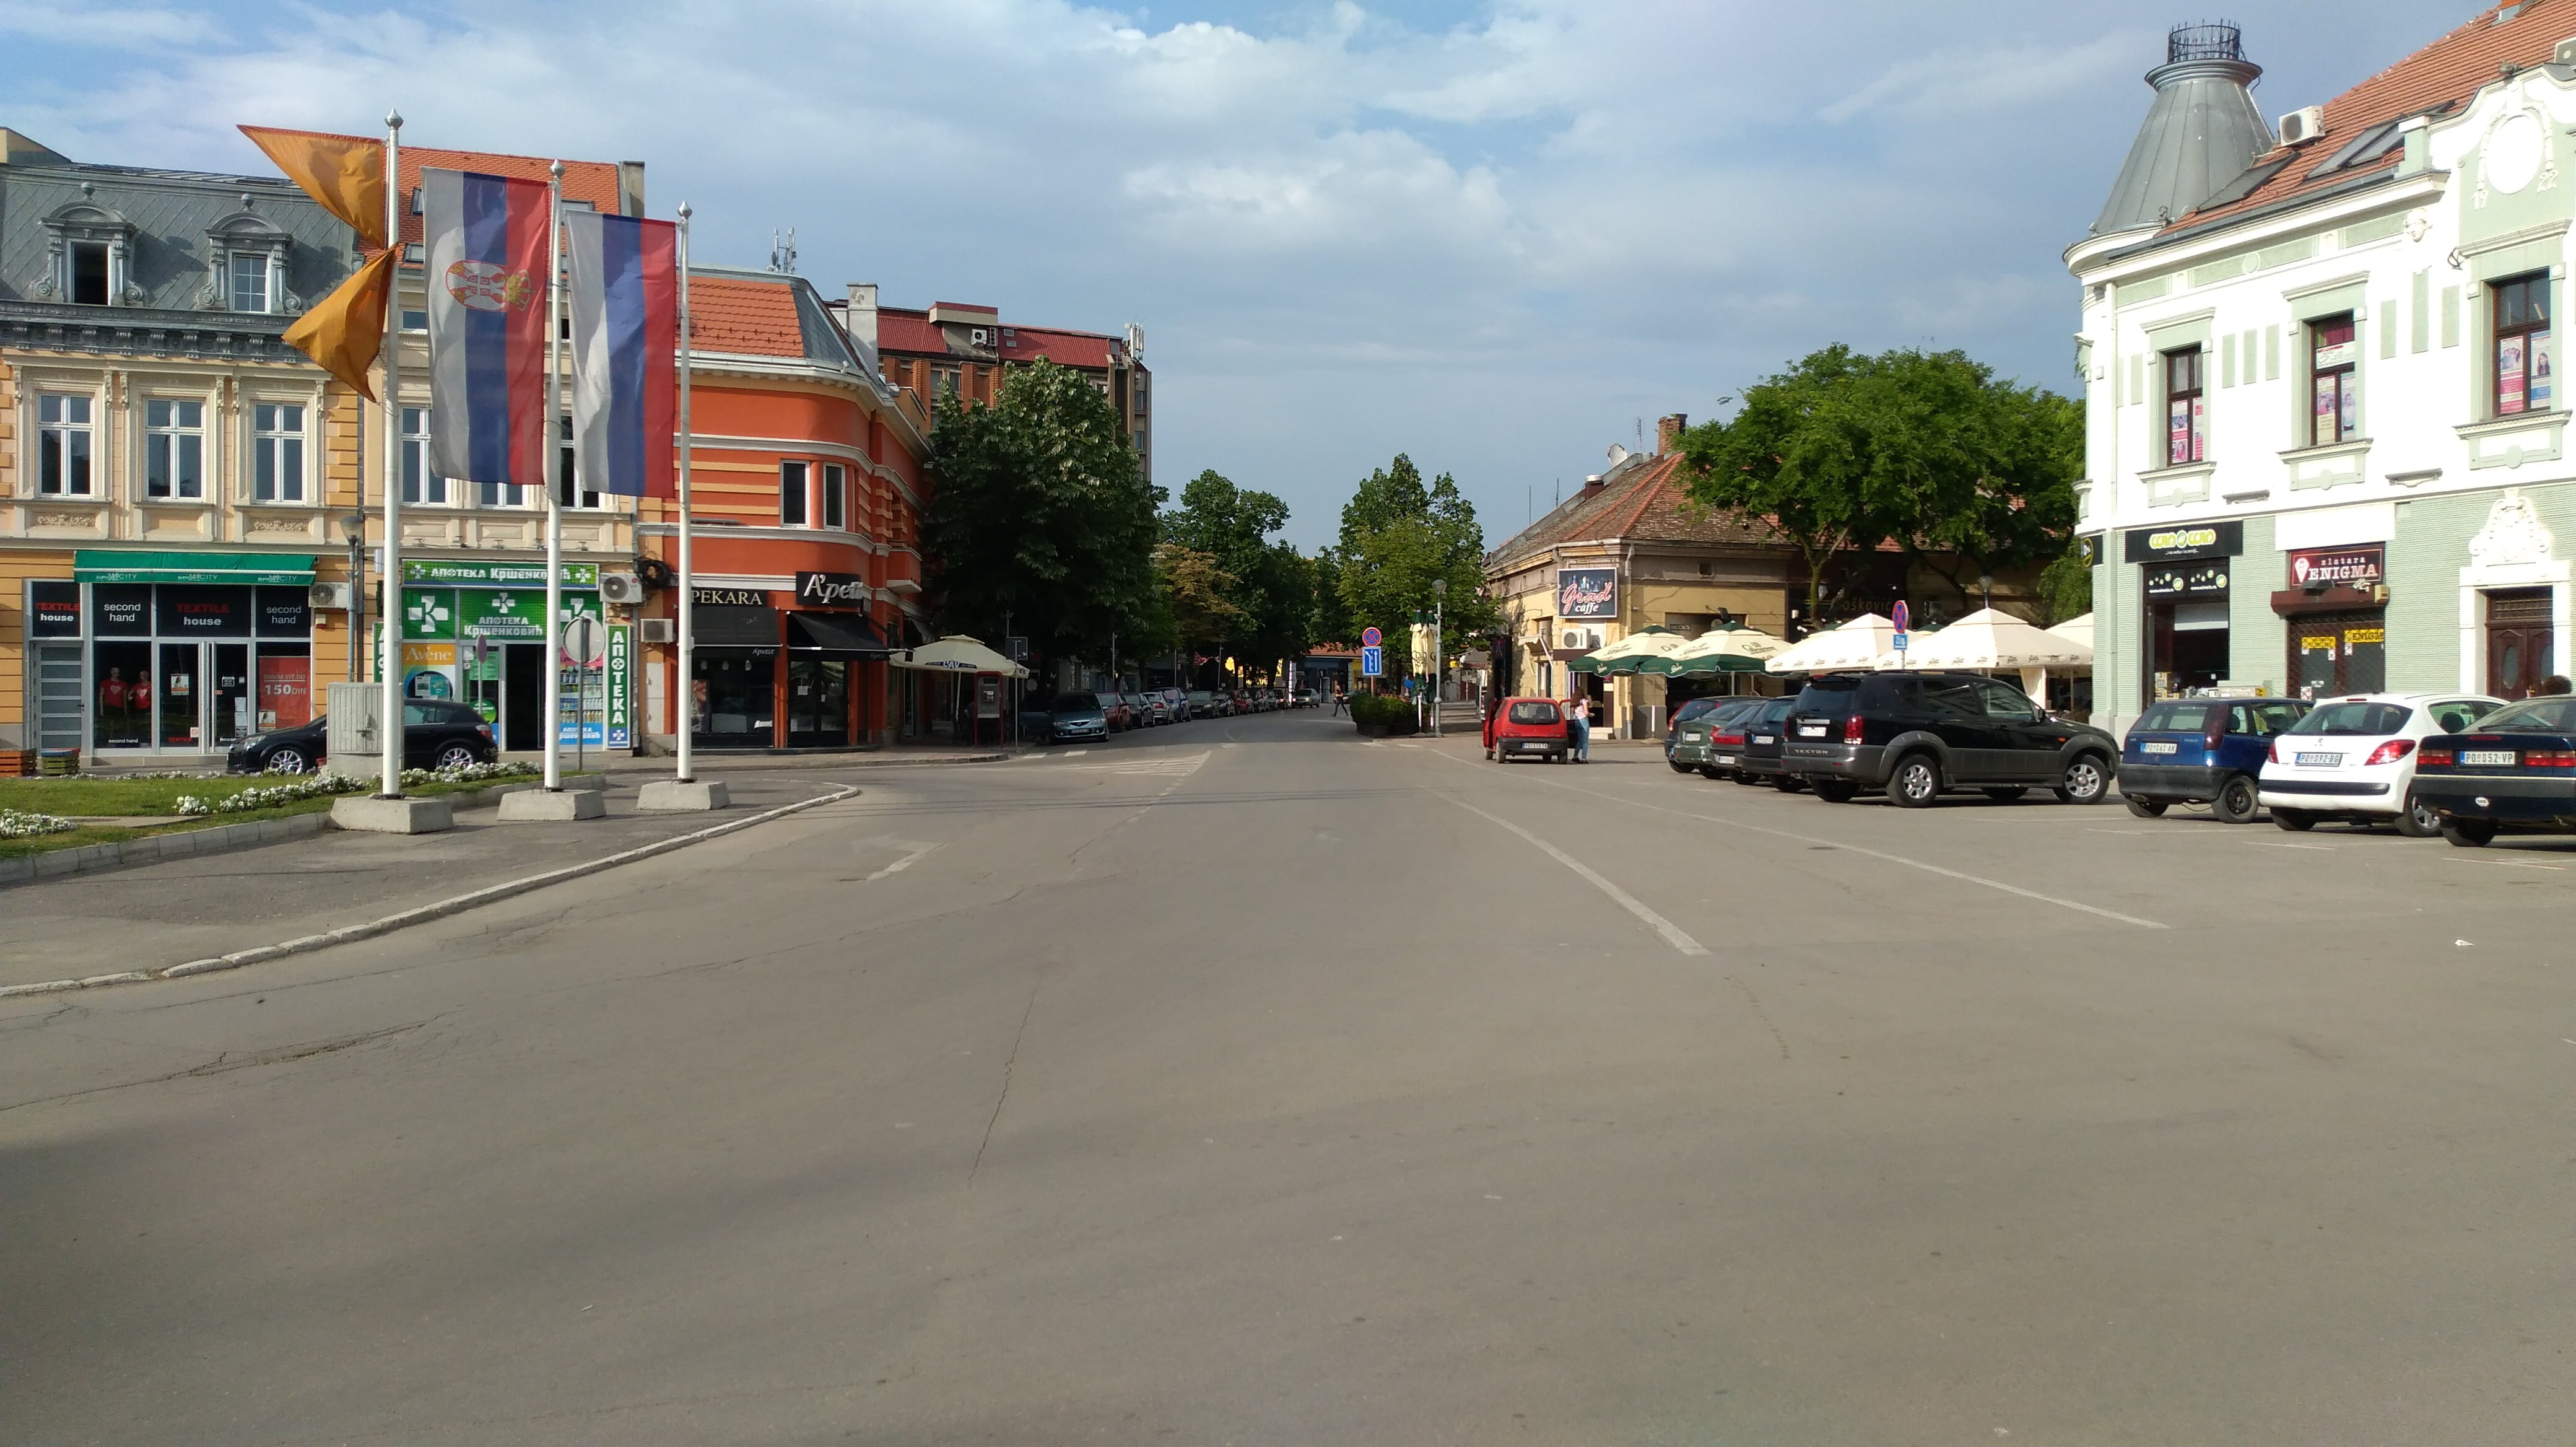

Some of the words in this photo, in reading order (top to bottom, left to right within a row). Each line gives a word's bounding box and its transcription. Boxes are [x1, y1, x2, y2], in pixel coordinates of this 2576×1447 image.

[2321, 557, 2365, 566] zlatara
[431, 567, 486, 579] АПОТЕКА
[490, 567, 571, 581] Кршенкоић
[2308, 564, 2378, 580] ENIGMA
[691, 590, 763, 605] PEKARA
[1561, 582, 1612, 615] Grad
[35, 602, 80, 611] TEXTILE
[104, 603, 141, 611] second
[176, 603, 230, 613] TEXTILE
[266, 605, 302, 614] second
[1575, 602, 1599, 614] caffe
[40, 613, 74, 622] house
[110, 613, 136, 622] hand
[183, 616, 222, 626] house
[271, 616, 296, 624] hand
[478, 616, 529, 625] АПОТЕКА
[2352, 632, 2384, 640] ENIGM
[611, 631, 625, 724] АПОТЕКА
